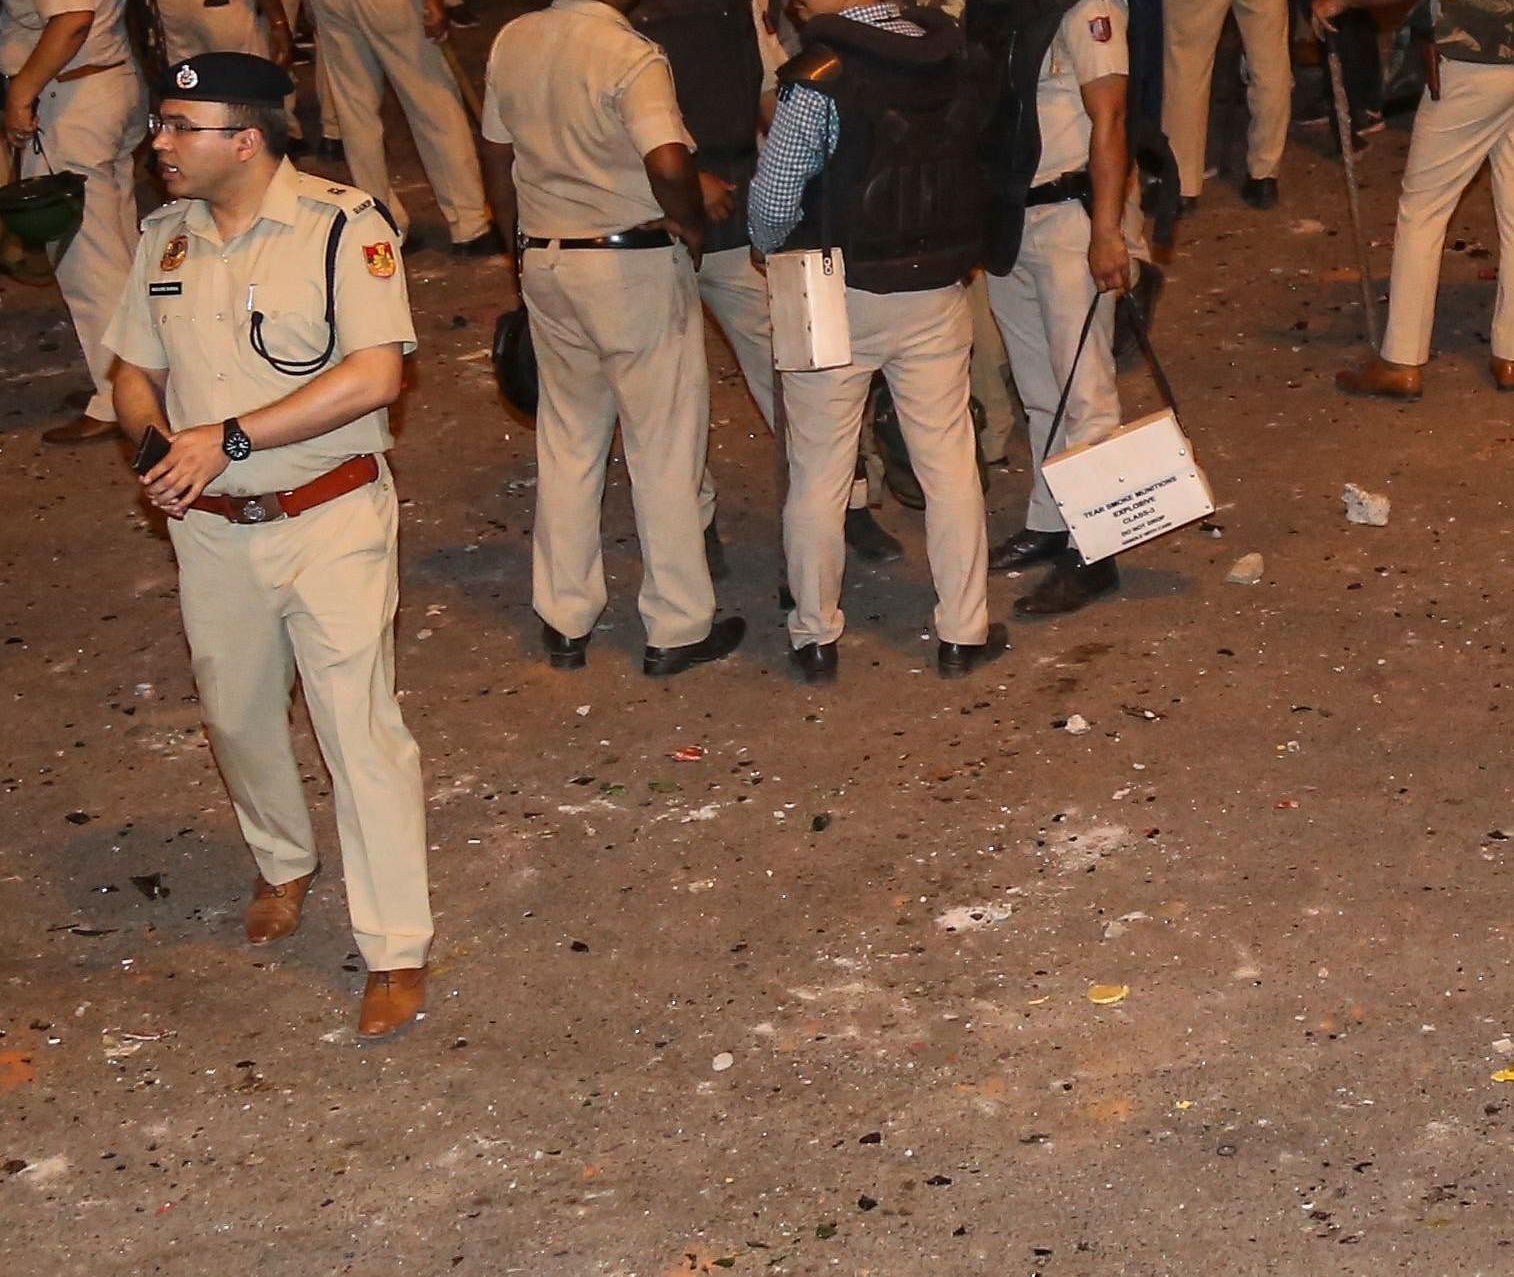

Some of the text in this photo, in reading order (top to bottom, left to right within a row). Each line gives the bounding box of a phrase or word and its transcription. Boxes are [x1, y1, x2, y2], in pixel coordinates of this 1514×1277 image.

[1084, 476, 1176, 518] TEAR SMOKE MUNITIONS
[1113, 497, 1155, 517] EXPLOSIVE
